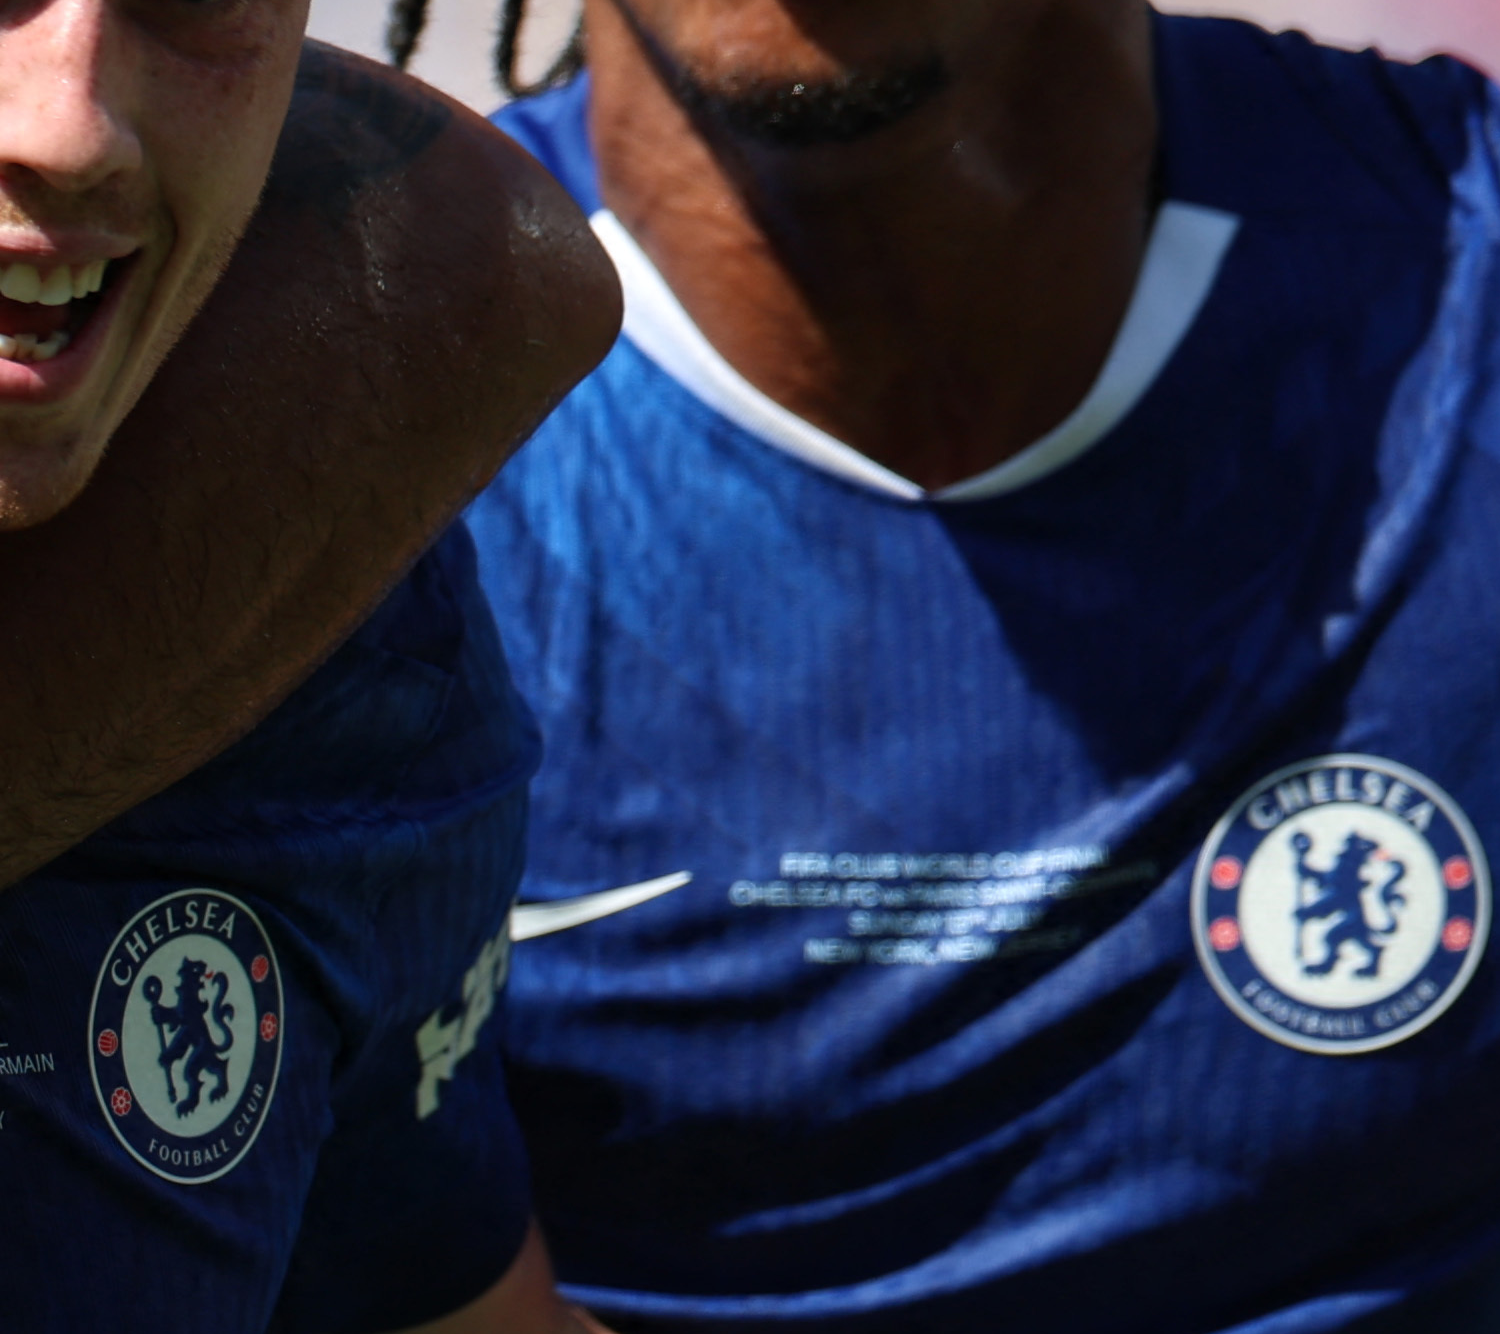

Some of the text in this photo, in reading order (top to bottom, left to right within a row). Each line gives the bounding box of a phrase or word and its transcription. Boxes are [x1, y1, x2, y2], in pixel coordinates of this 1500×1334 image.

[1246, 767, 1437, 832] CHELSEA
[111, 900, 238, 987] CHELSEA
[148, 1081, 265, 1167] FOOTBALL CLUB
